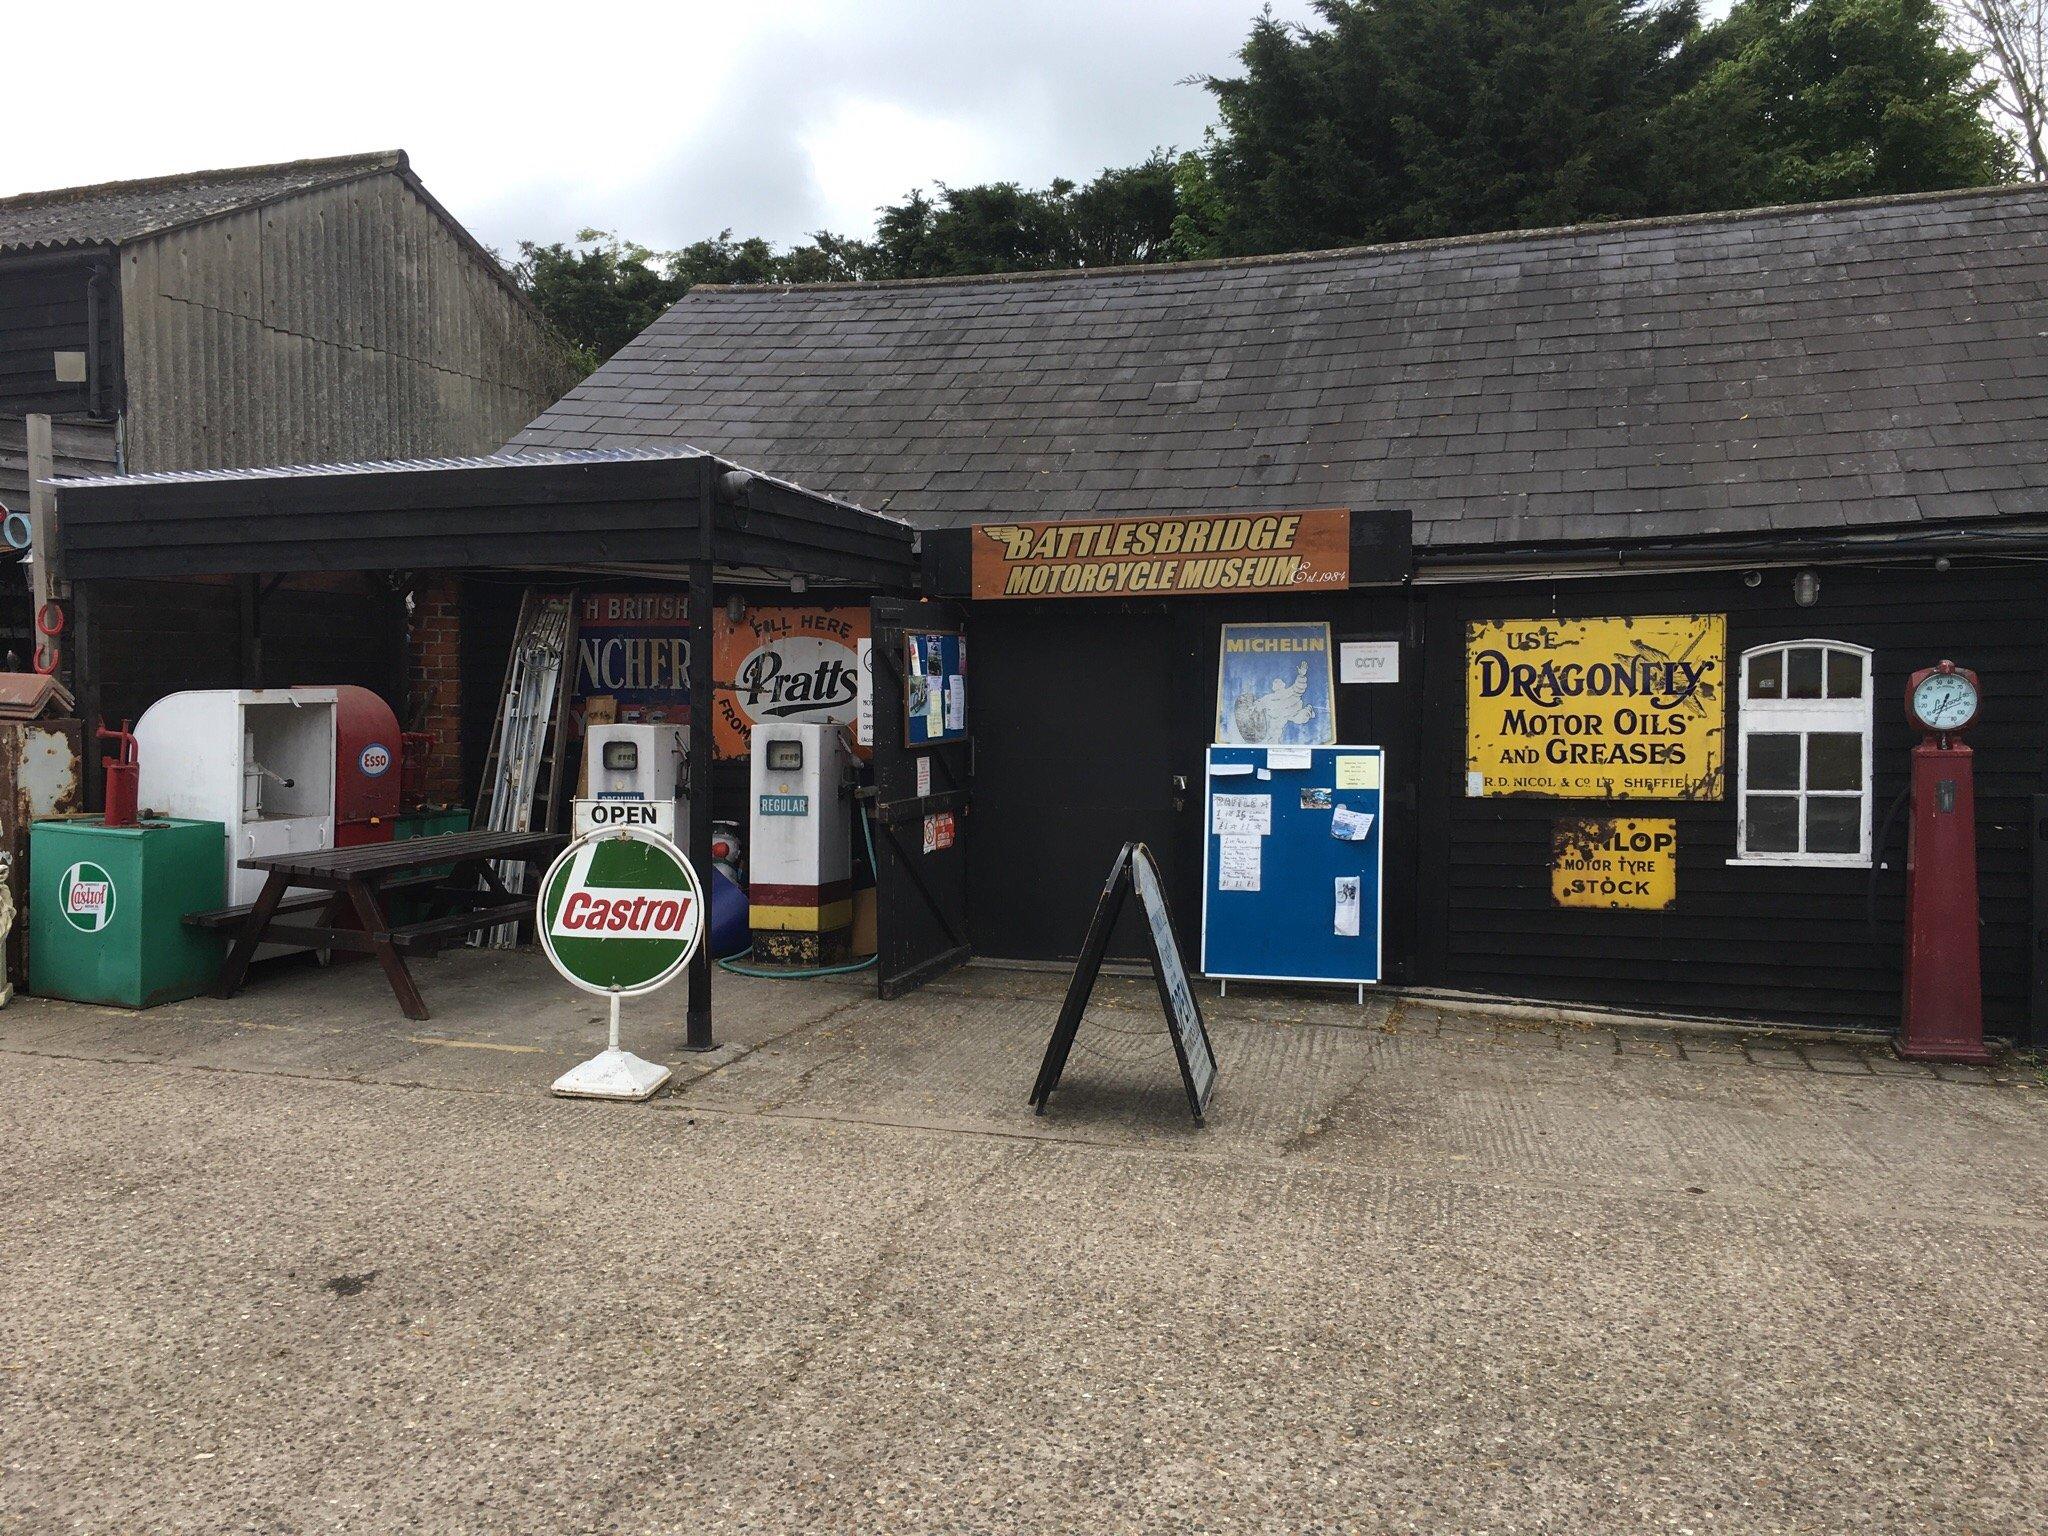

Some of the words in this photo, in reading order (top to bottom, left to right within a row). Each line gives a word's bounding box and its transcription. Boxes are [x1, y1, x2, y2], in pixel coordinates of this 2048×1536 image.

[1003, 514, 1301, 560] BATTLESBRIDGE
[1003, 560, 1179, 595] MOTORCYCLE
[1176, 555, 1302, 590] MUSEUM
[608, 598, 689, 620] BRITISH
[750, 616, 792, 638] FILL
[801, 615, 853, 639] HERE
[1226, 638, 1325, 653] MICHELIN
[1507, 631, 1558, 650] USE
[1355, 657, 1386, 669] CCTV
[743, 651, 858, 713] Pratts
[718, 699, 751, 741] FROM
[1500, 709, 1604, 736] MOTOR
[1614, 708, 1686, 735] OILS
[1500, 748, 1540, 764] AND
[1545, 738, 1686, 765] GREASES
[1513, 778, 1557, 787] NICOL
[1561, 778, 1570, 788] &
[591, 805, 657, 824] OPEN
[761, 799, 806, 812] REGULAR
[1565, 859, 1612, 871] MOTOR
[1618, 860, 1656, 873] TYRE
[71, 882, 107, 912] Castrol
[1571, 879, 1650, 896] STOCK
[562, 891, 692, 932] Castrol
